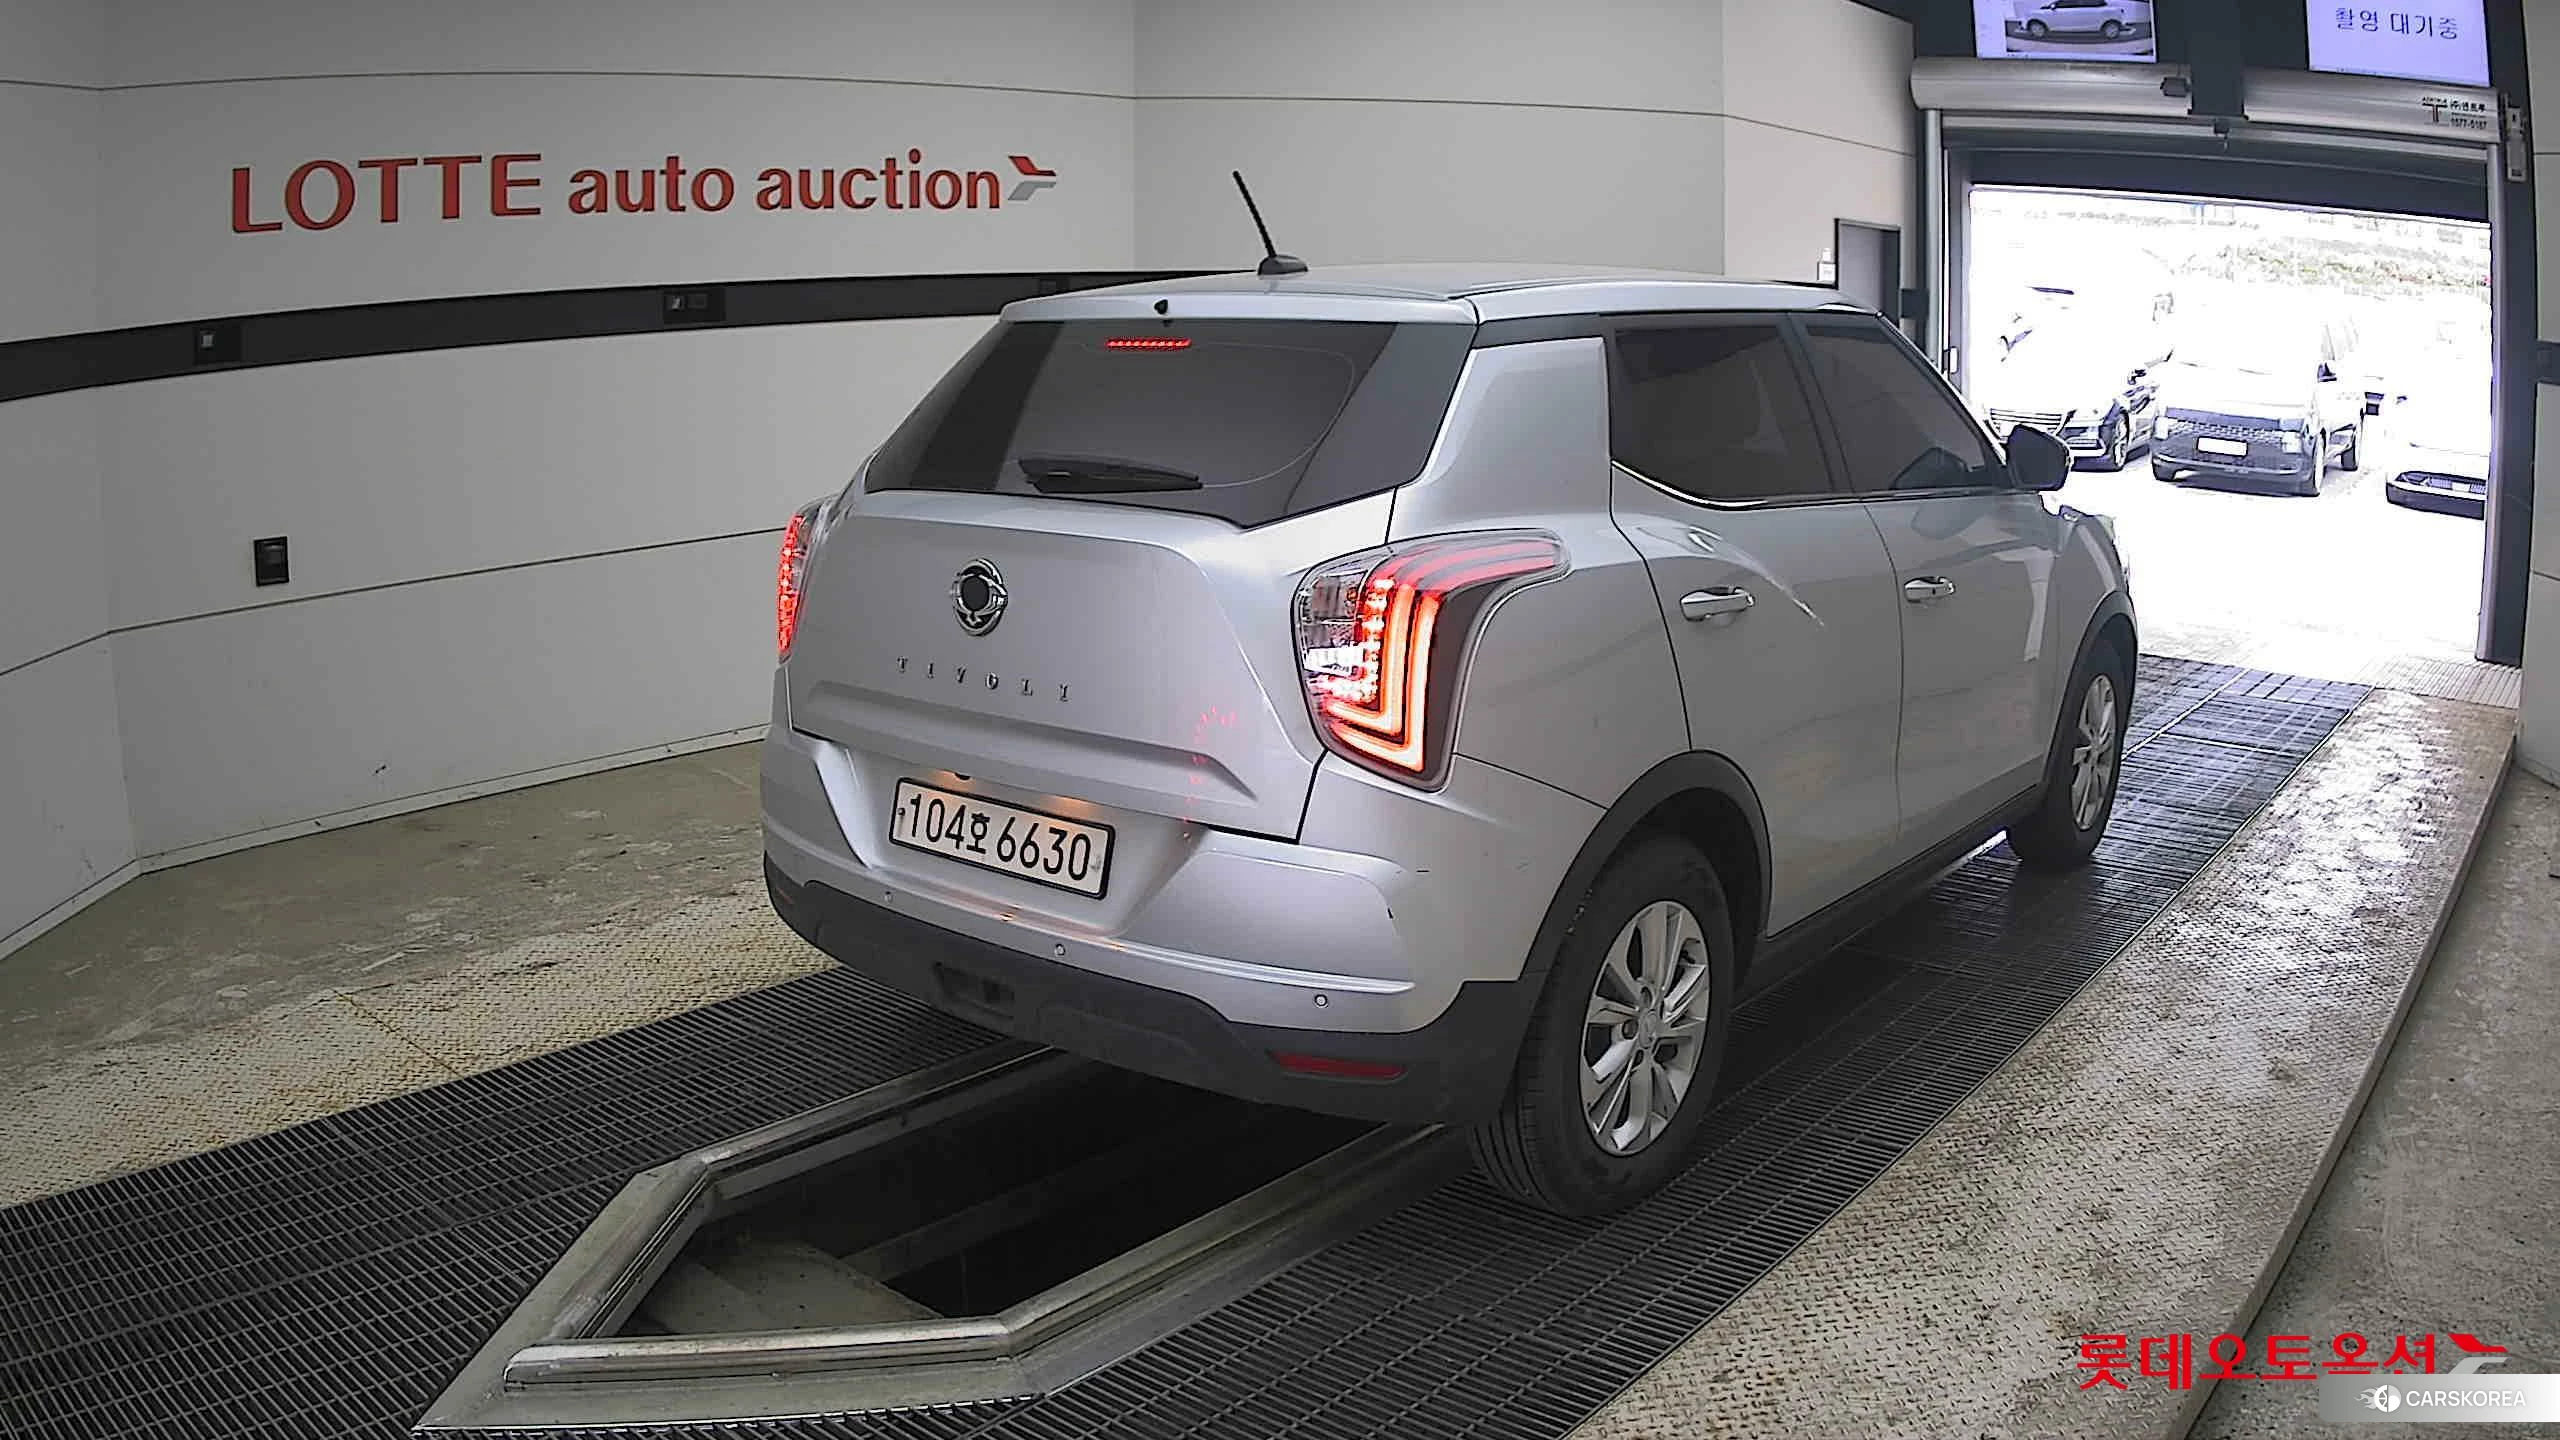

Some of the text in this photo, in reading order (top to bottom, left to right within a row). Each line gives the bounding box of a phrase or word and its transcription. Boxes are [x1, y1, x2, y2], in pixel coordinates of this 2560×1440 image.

[2390, 12, 2457, 40] 대기중
[231, 148, 1001, 234] LOTTE auto auction
[897, 656, 1072, 702] TIVOLI
[997, 816, 1091, 881] 6630
